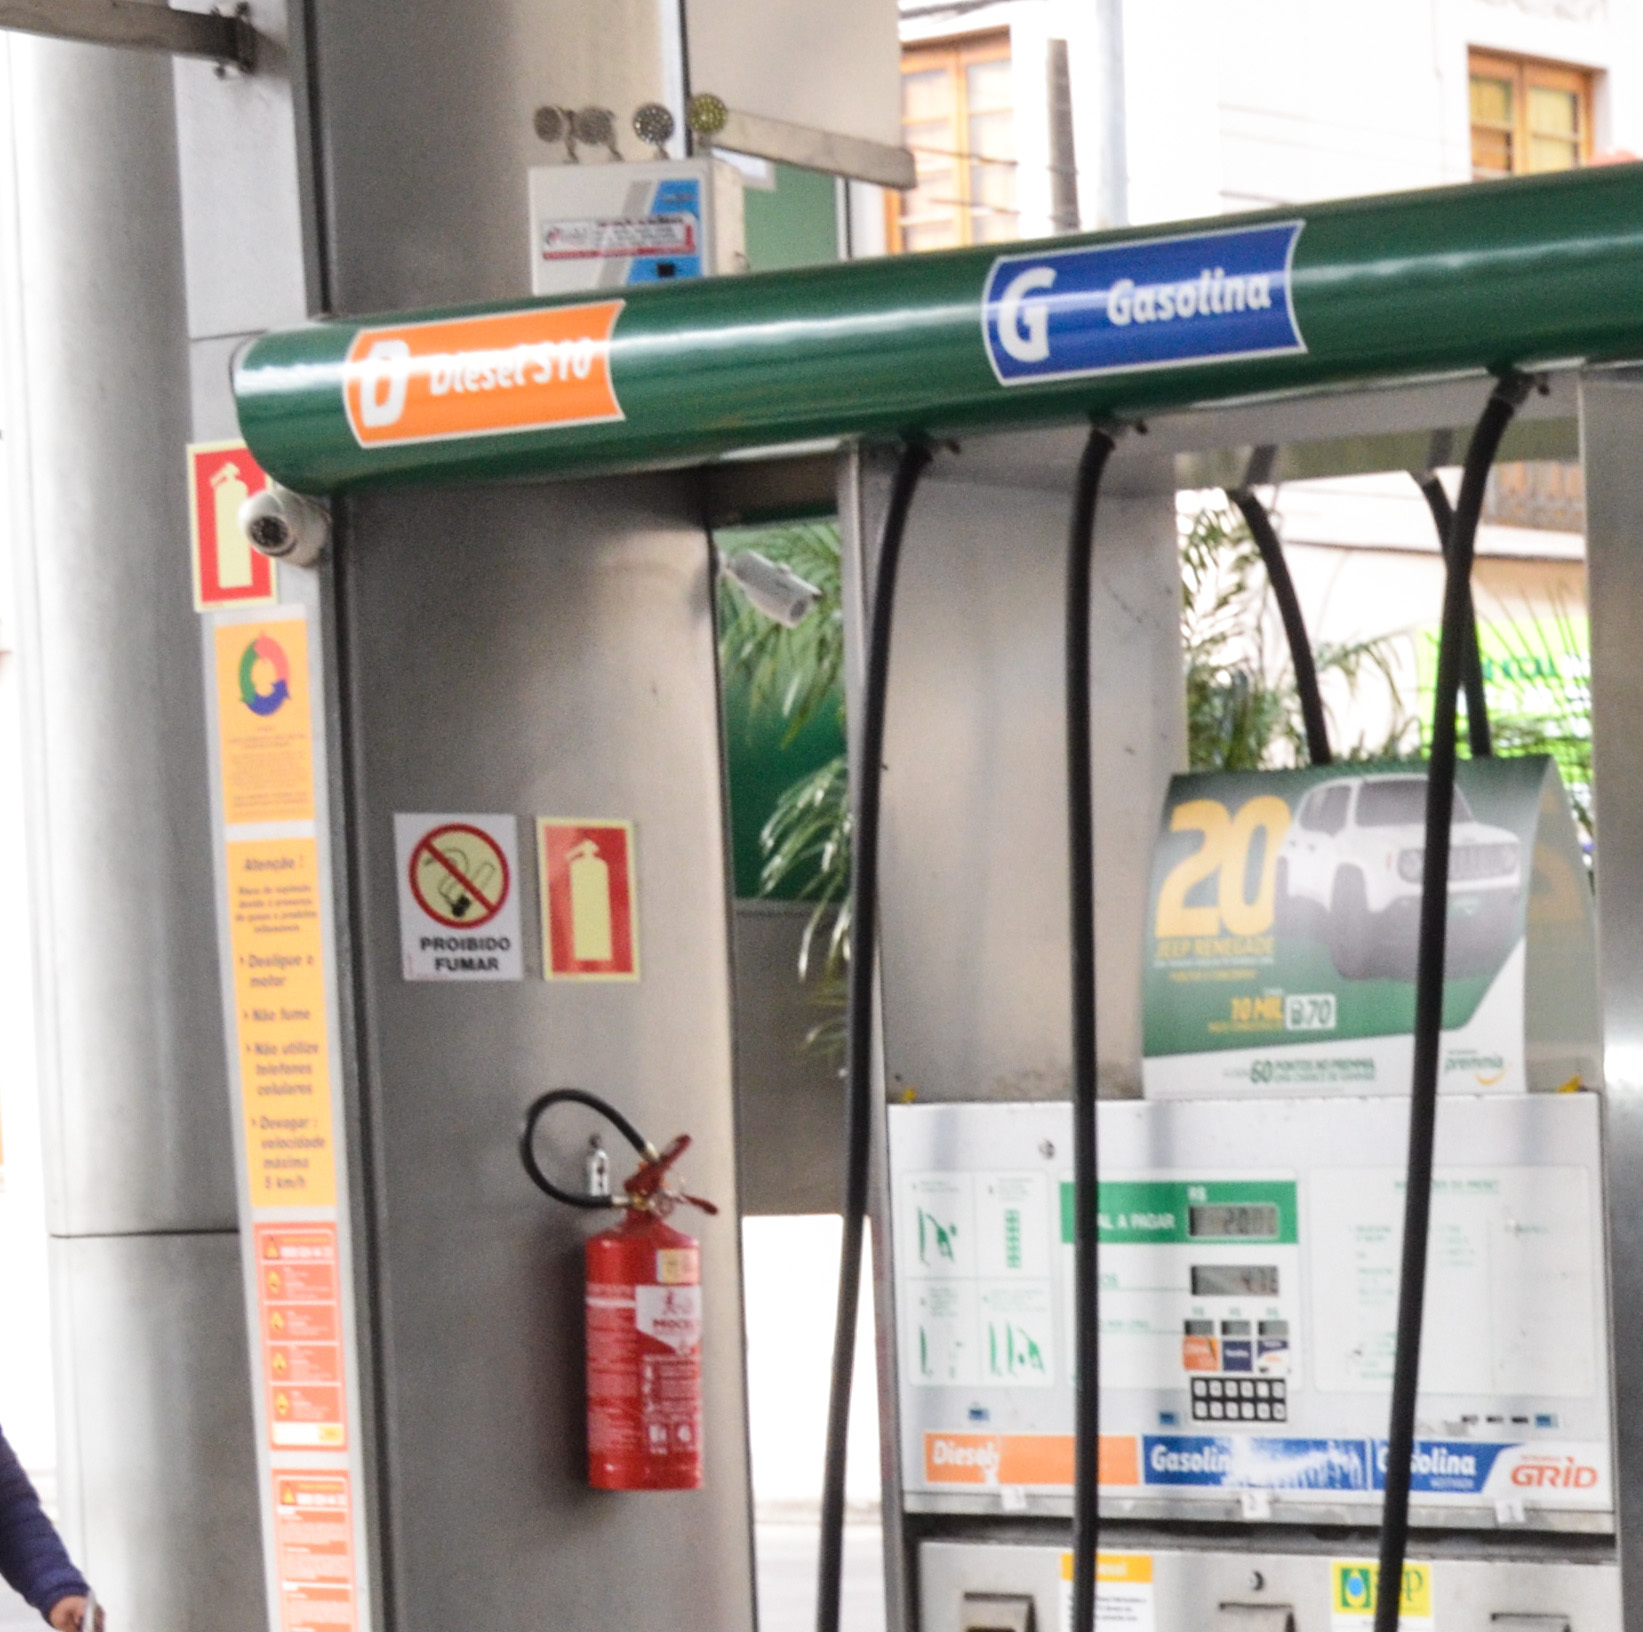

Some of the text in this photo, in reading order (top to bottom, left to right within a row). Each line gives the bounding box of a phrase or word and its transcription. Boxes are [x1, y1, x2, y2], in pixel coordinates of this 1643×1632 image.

[999, 267, 1272, 362] G Gasolina
[360, 338, 595, 428] D Diesel S10
[1155, 795, 1293, 939] 20
[419, 937, 511, 952] PROIBIDO
[434, 957, 499, 972] FUMAR
[1151, 1444, 1237, 1474] Gasolin
[1376, 1445, 1477, 1478] Gsolina
